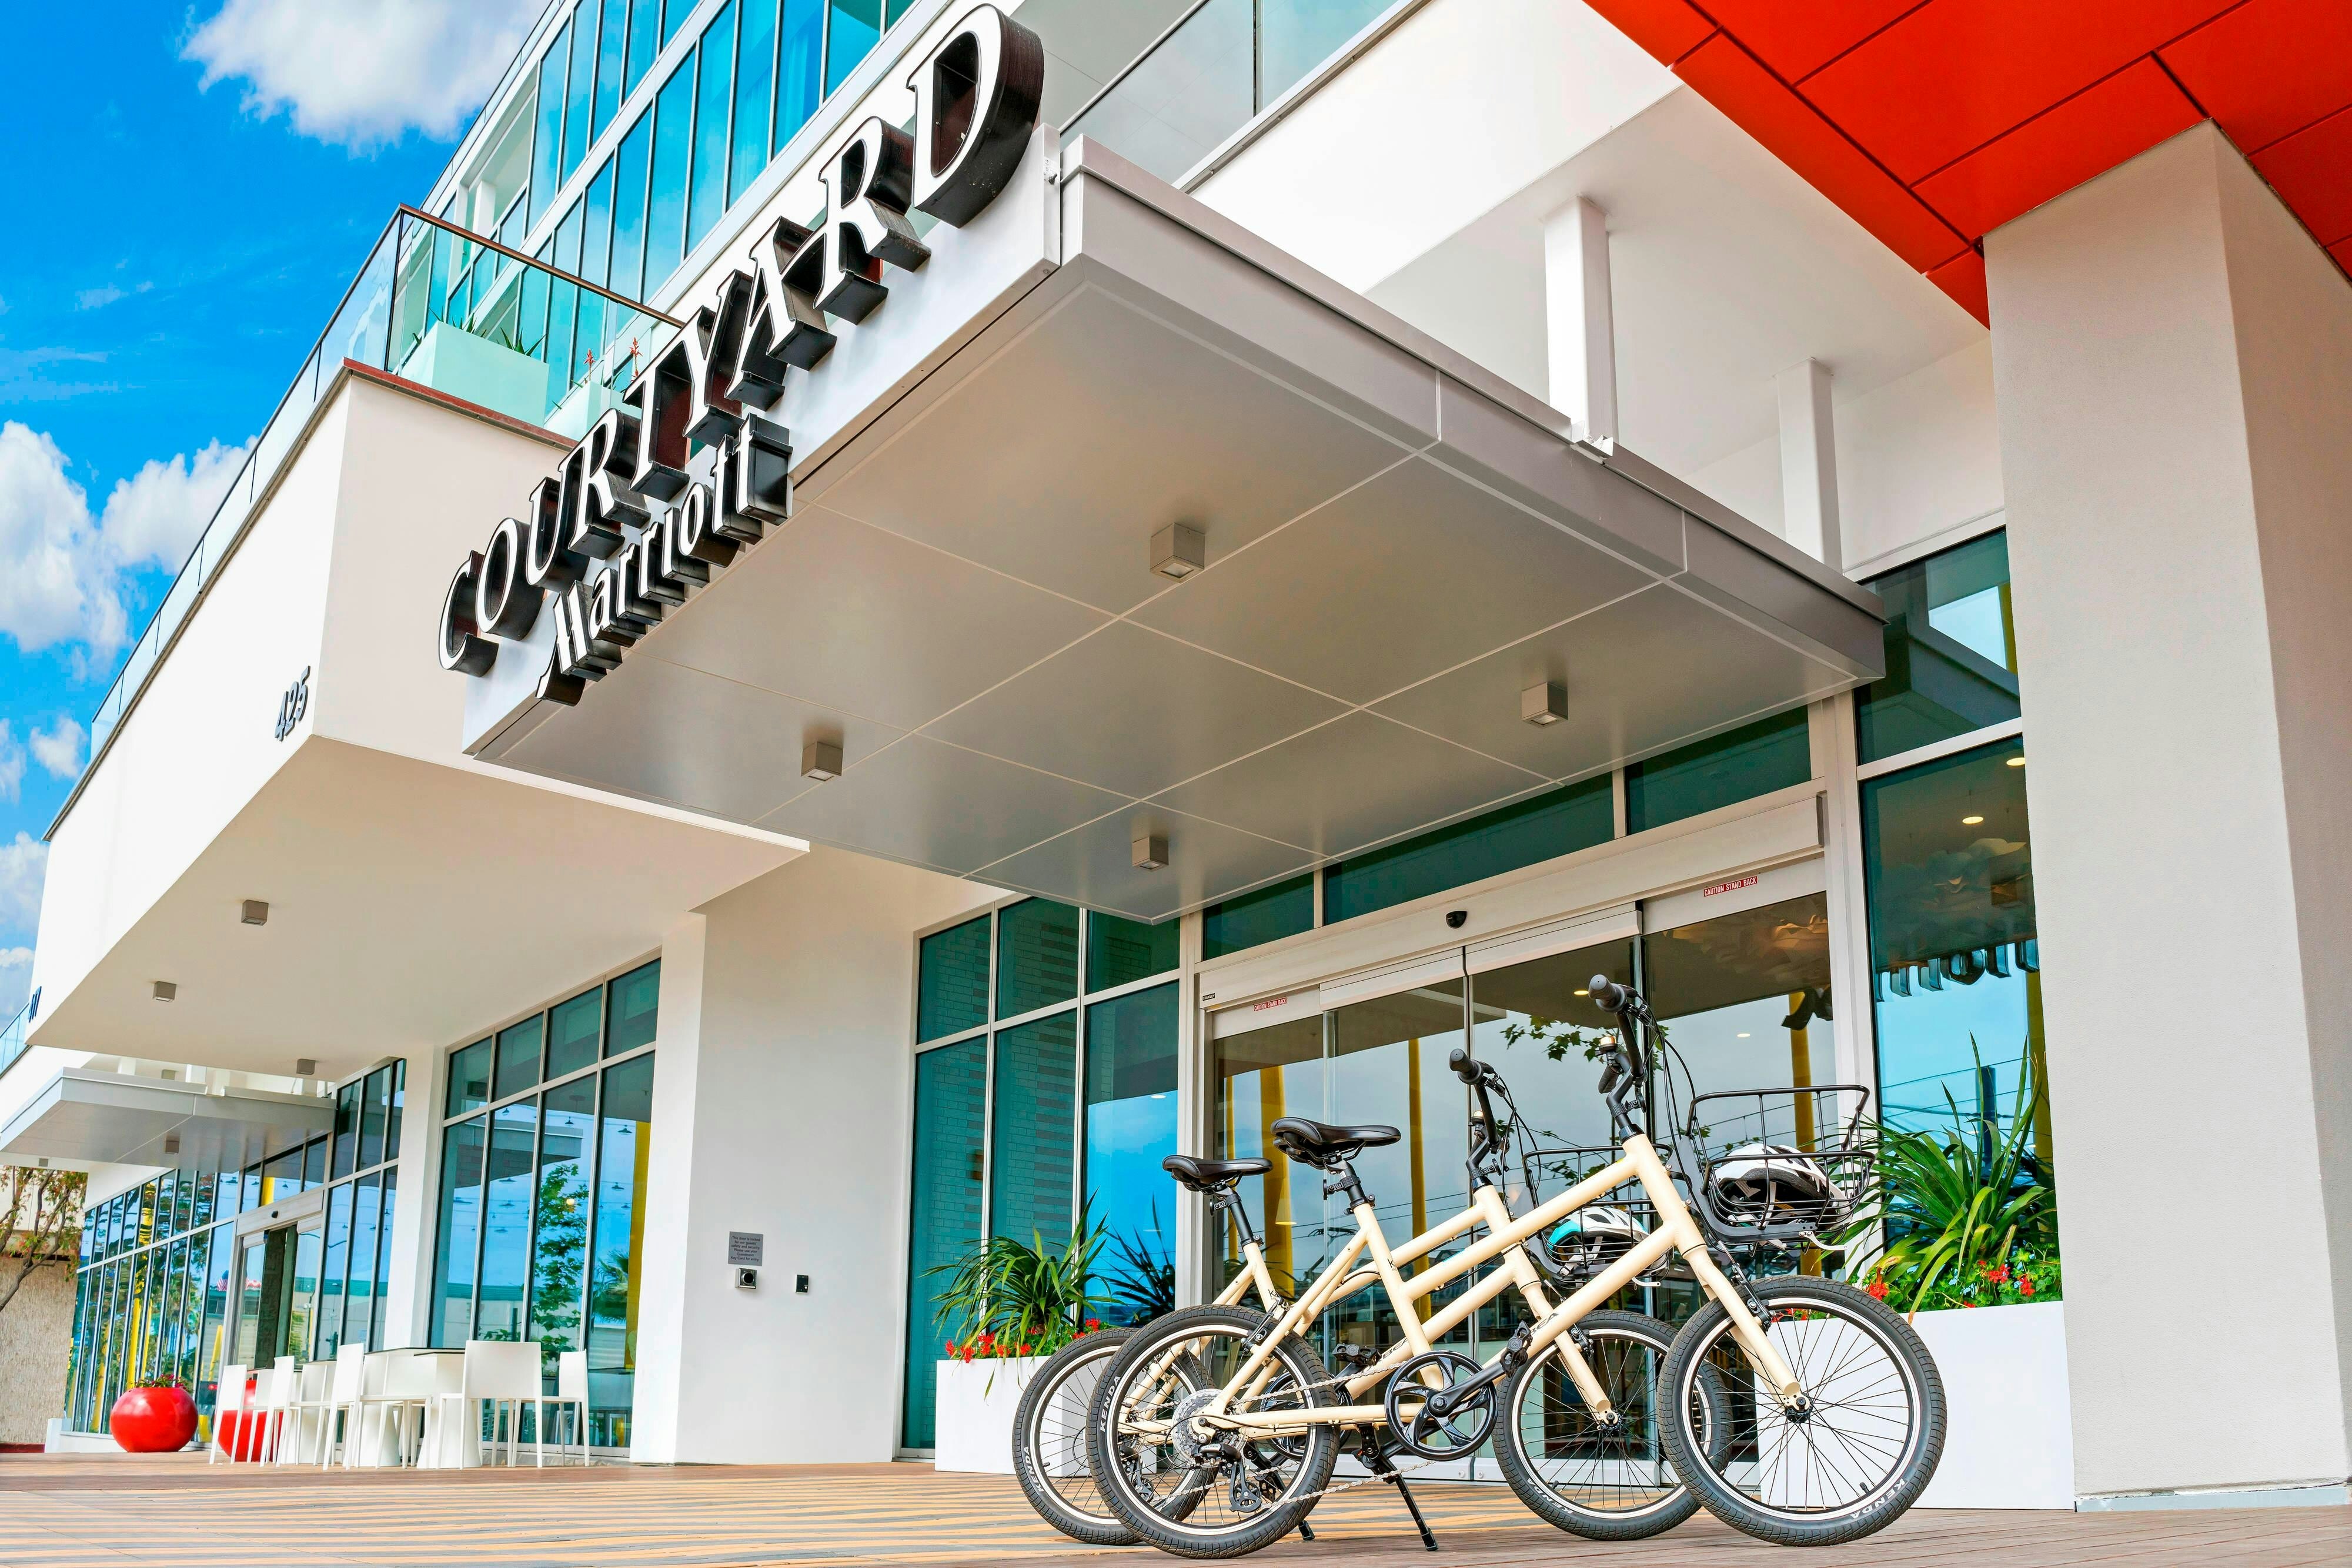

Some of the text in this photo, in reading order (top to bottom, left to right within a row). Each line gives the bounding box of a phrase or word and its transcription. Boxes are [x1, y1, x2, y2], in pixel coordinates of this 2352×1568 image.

[438, 3, 1044, 677] COURTYARD
[536, 413, 793, 706] Marriott
[275, 666, 310, 741] 425
[1704, 877, 1756, 897] CAUTION STAND BACK
[1254, 1003, 1267, 1011] CAUTION
[1100, 1376, 1121, 1432] KENDA
[1024, 1446, 1045, 1492] KENDA
[1527, 1477, 1574, 1514] KENDA
[1850, 1478, 1906, 1519] KENDA
